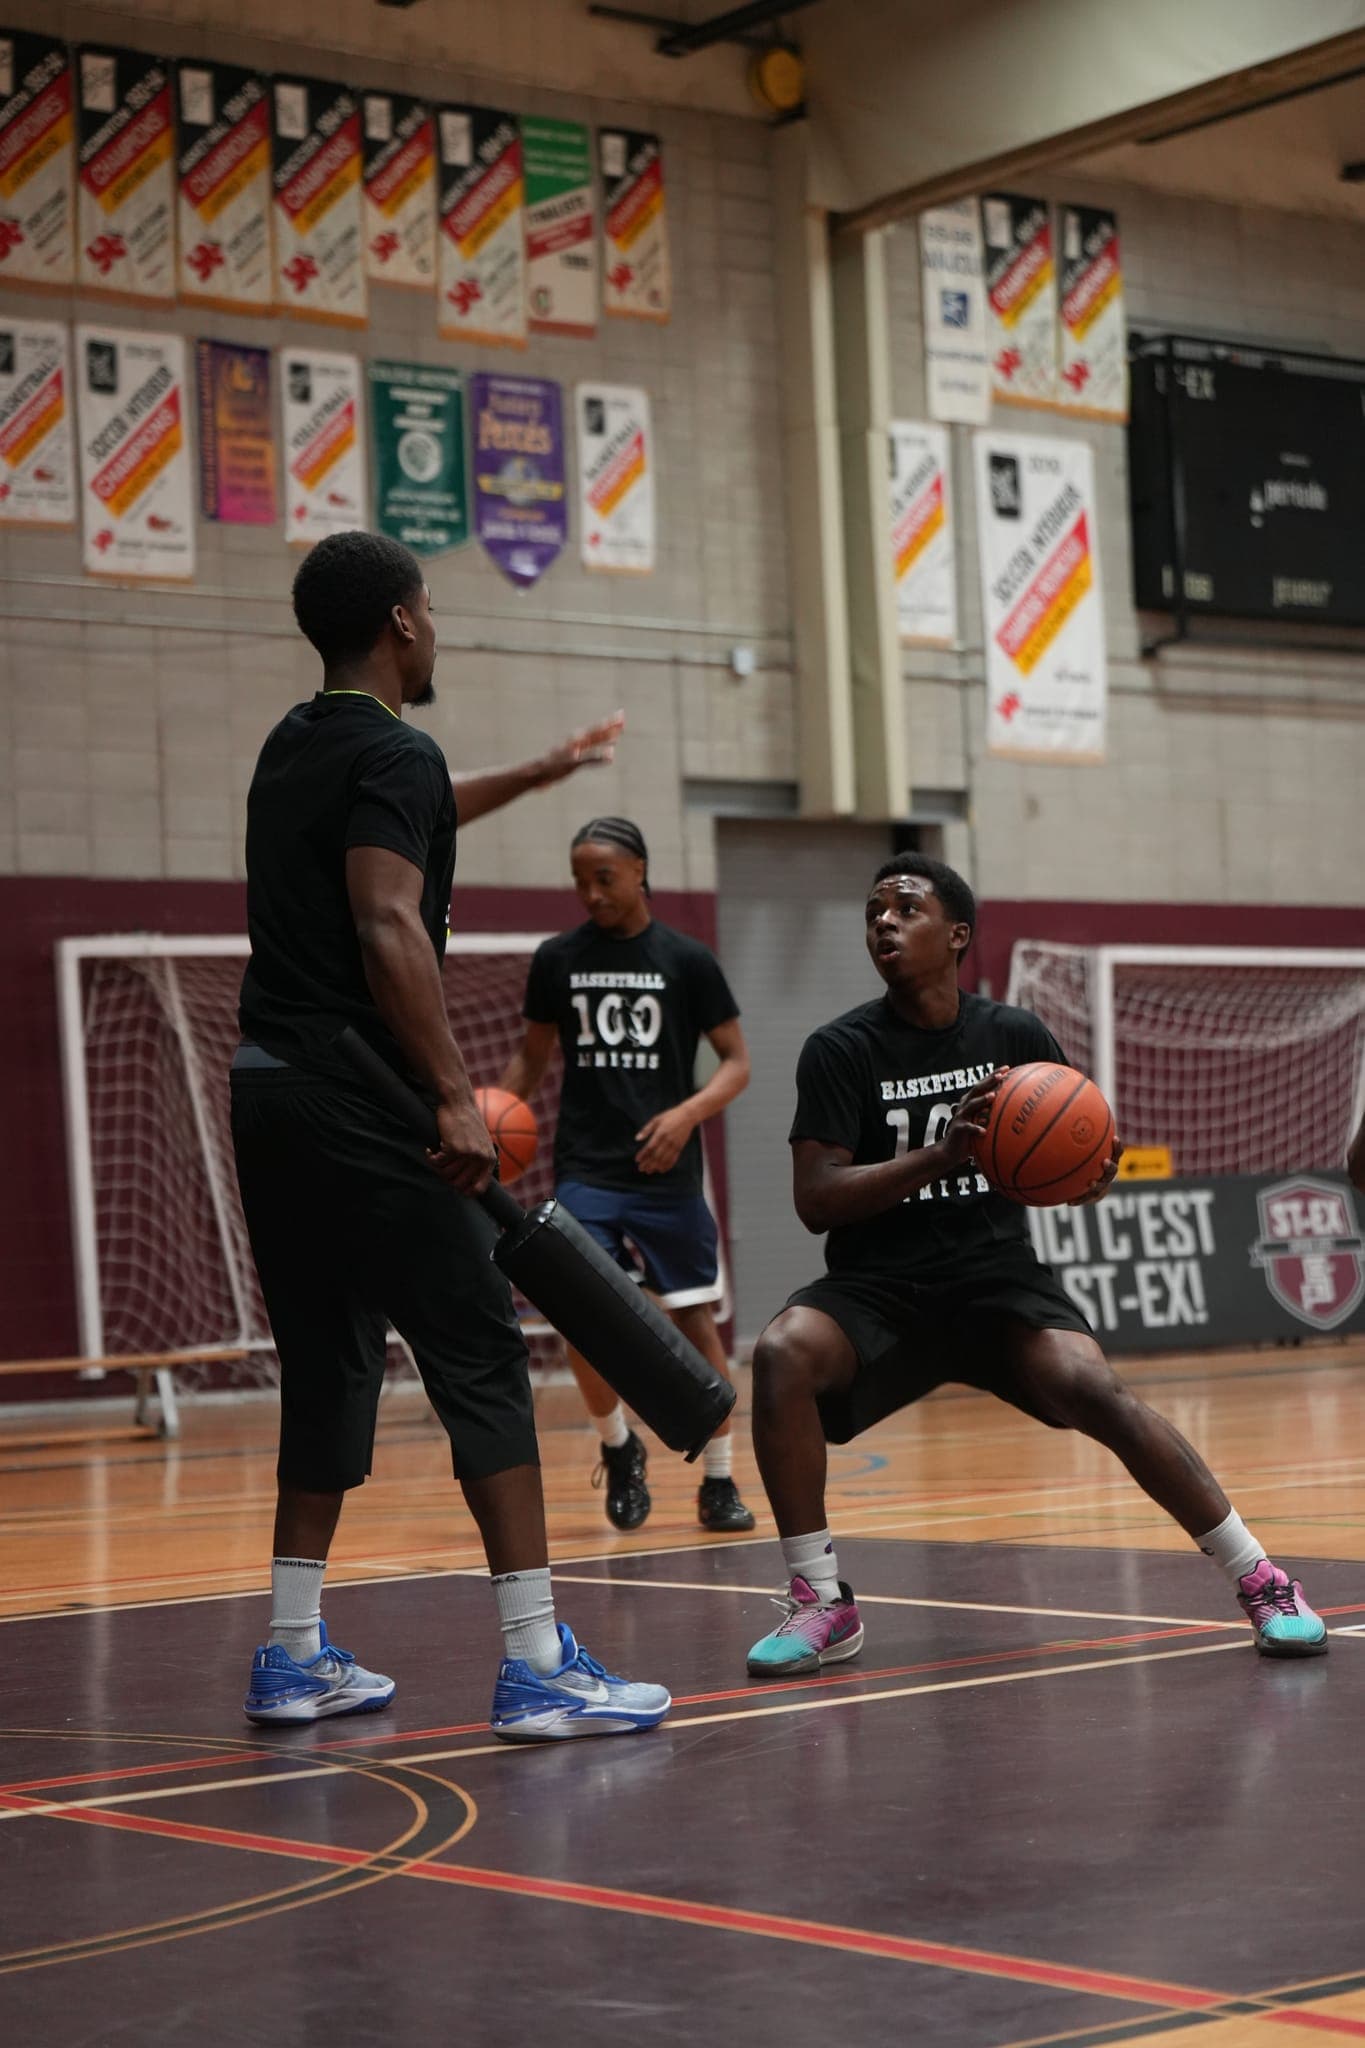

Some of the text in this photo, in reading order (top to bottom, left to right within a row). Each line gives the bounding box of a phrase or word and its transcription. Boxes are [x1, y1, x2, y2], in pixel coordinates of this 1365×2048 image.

[0, 358, 57, 424] ASKETBALL
[569, 971, 666, 990] BASKETBALL
[571, 993, 662, 1047] 100
[886, 1102, 961, 1161] 10
[903, 1173, 990, 1203] MITE
[1026, 1187, 1216, 1265] ICI C'EST
[1269, 1199, 1346, 1238] ST-EX
[1061, 1257, 1210, 1331] ST-EX!
[274, 1559, 319, 1569] Reebok
